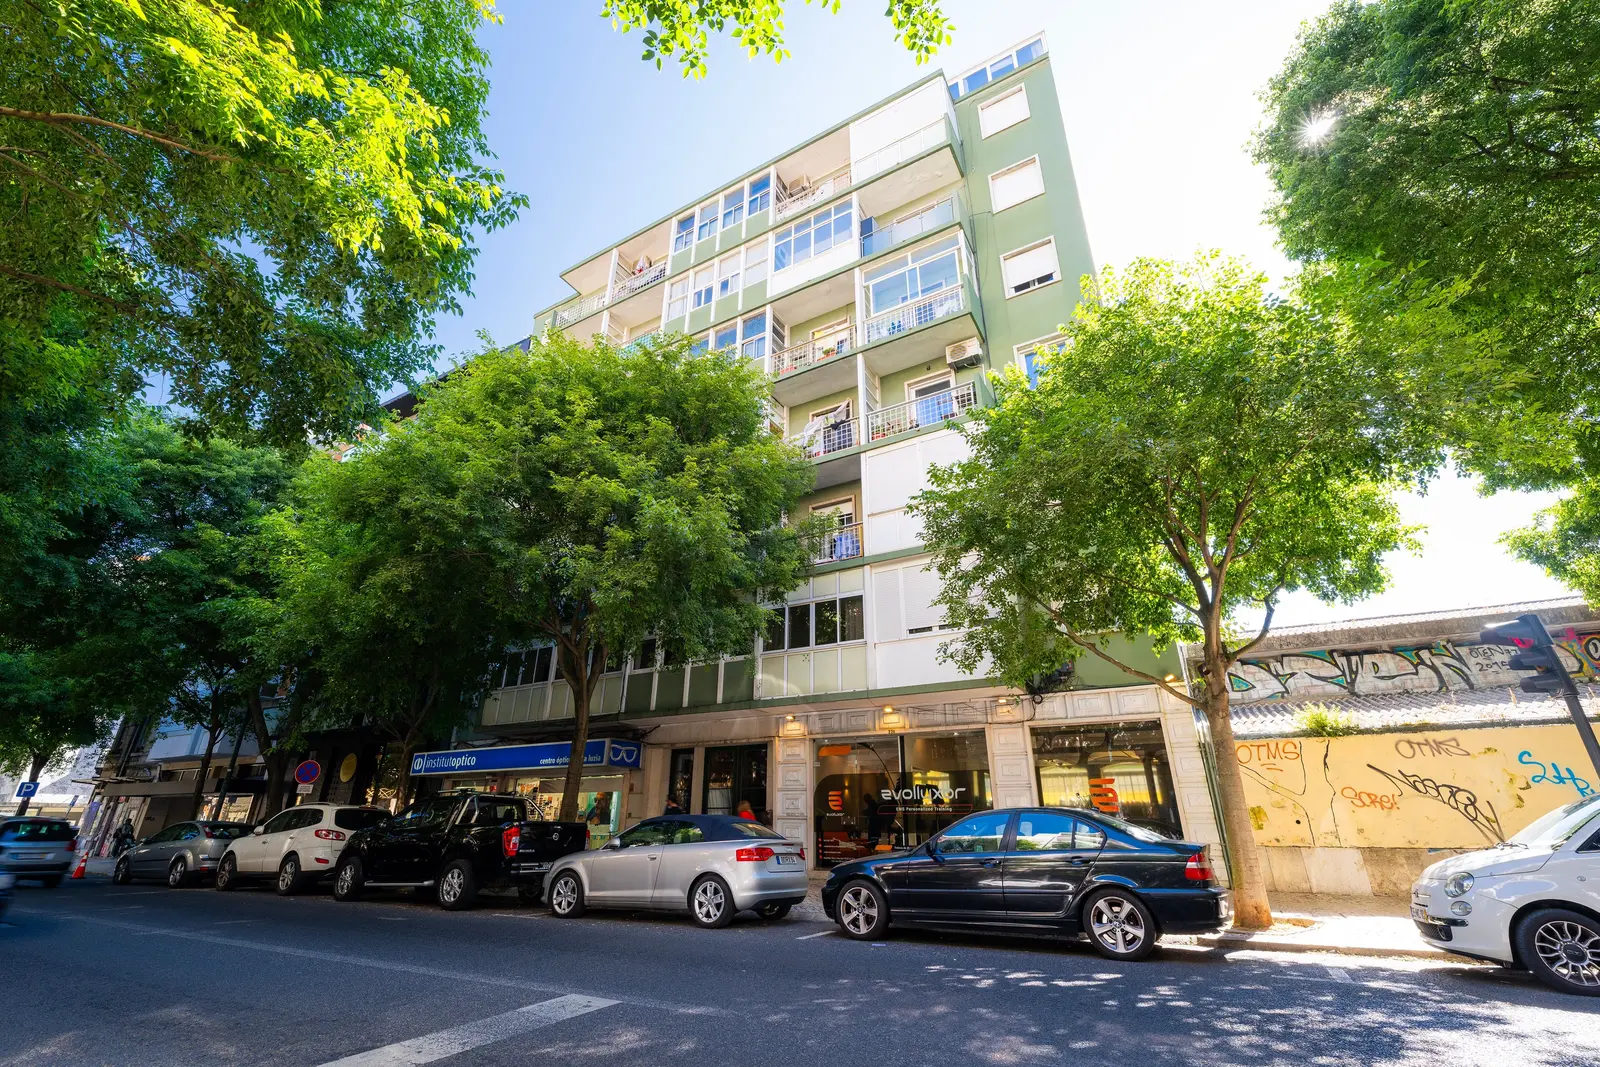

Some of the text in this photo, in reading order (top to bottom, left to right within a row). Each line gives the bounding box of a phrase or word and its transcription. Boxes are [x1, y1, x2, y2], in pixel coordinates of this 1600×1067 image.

[1235, 741, 1300, 764] OTMS
[425, 754, 476, 769] institutoptico
[556, 755, 571, 765] óptic
[20, 783, 35, 796] P
